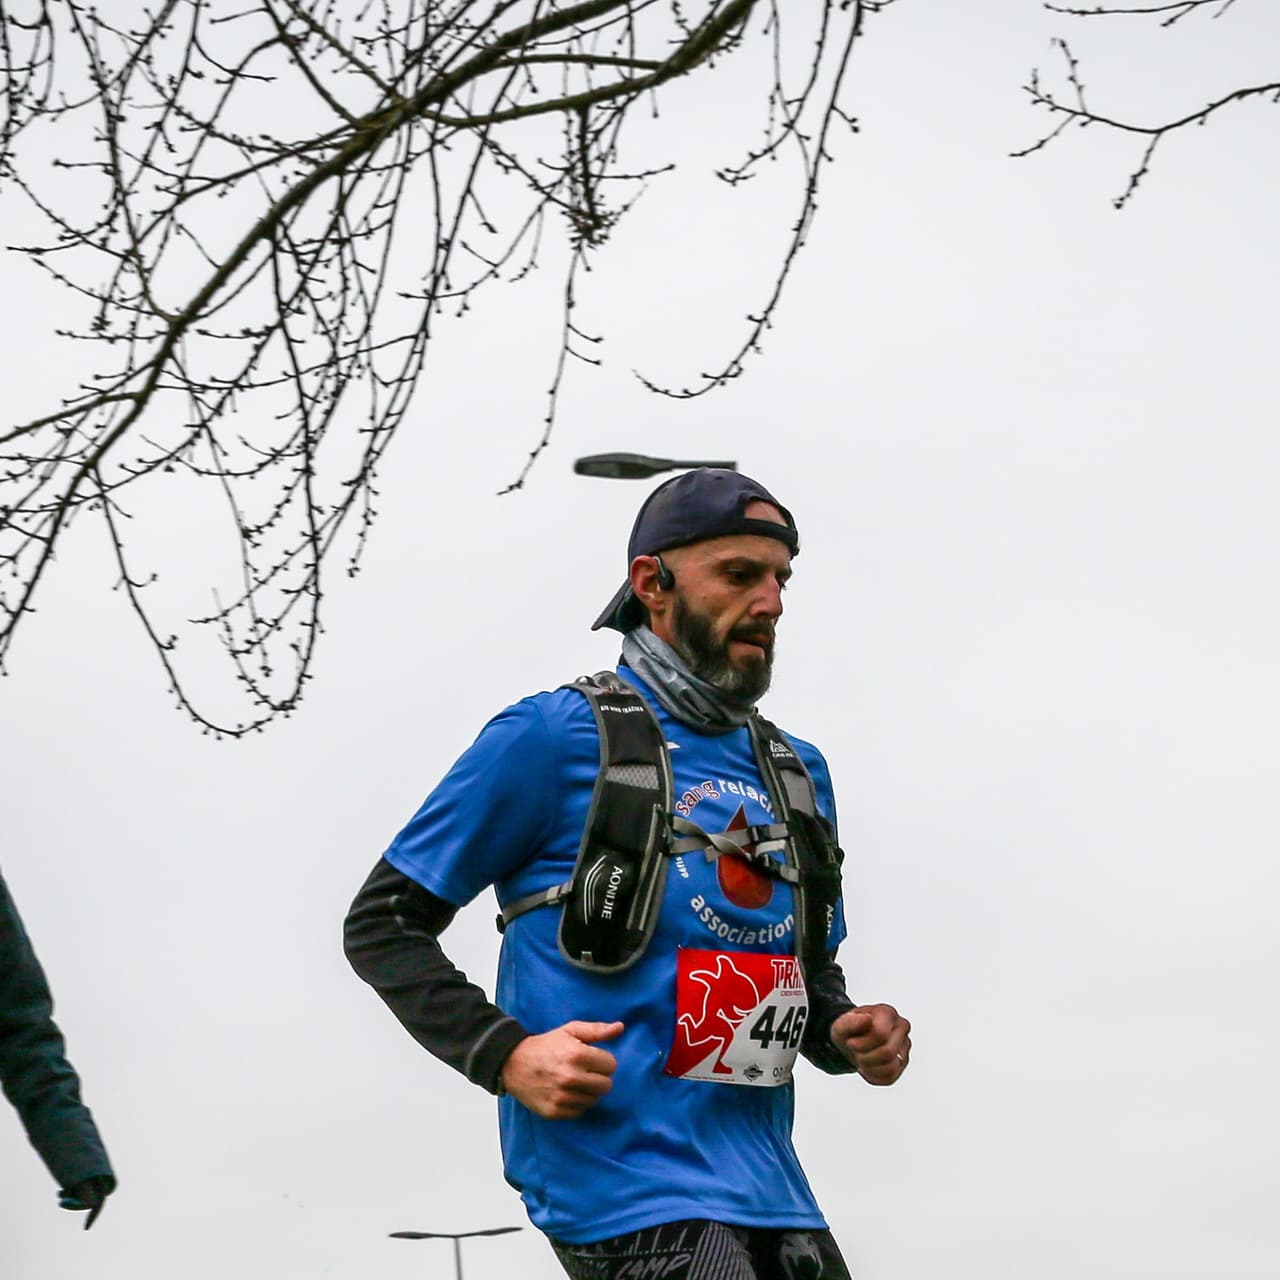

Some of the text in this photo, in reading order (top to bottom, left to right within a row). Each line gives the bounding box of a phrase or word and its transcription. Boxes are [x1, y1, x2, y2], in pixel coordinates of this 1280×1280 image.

[675, 780, 720, 816] sang
[601, 865, 624, 920] AONIJIE
[689, 894, 794, 944] association
[749, 1005, 807, 1050] 446
